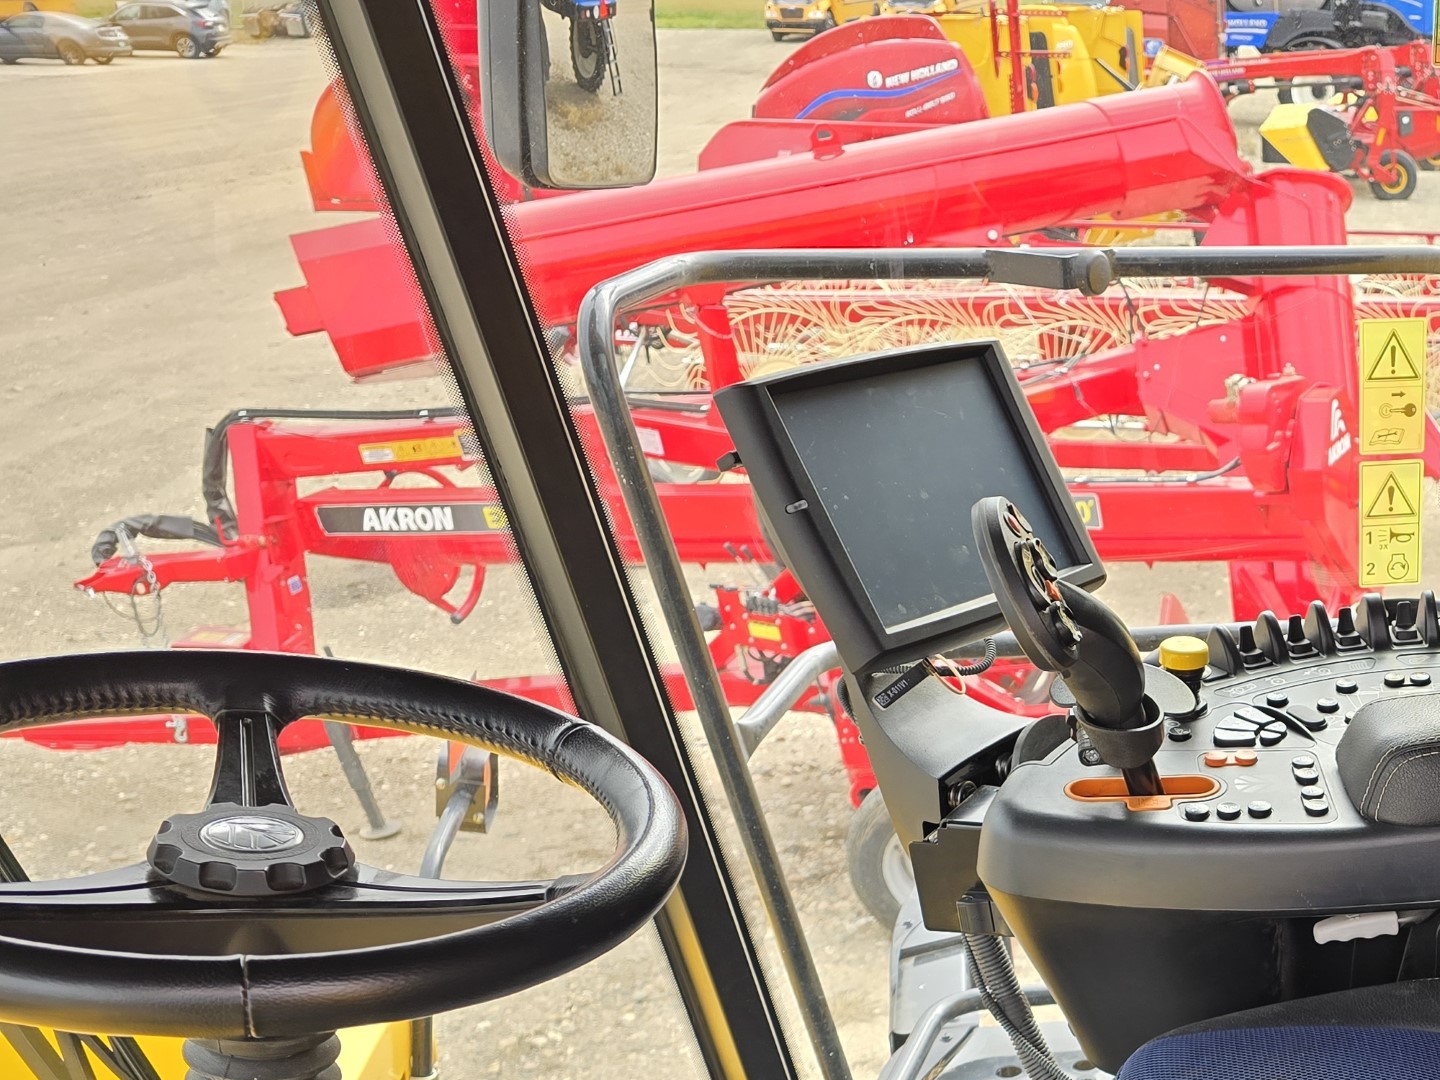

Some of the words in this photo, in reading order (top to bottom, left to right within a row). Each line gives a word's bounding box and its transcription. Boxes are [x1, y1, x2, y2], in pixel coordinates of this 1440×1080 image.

[362, 506, 454, 531] AKRON
[1366, 531, 1373, 545] 1
[1366, 562, 1376, 576] 2
